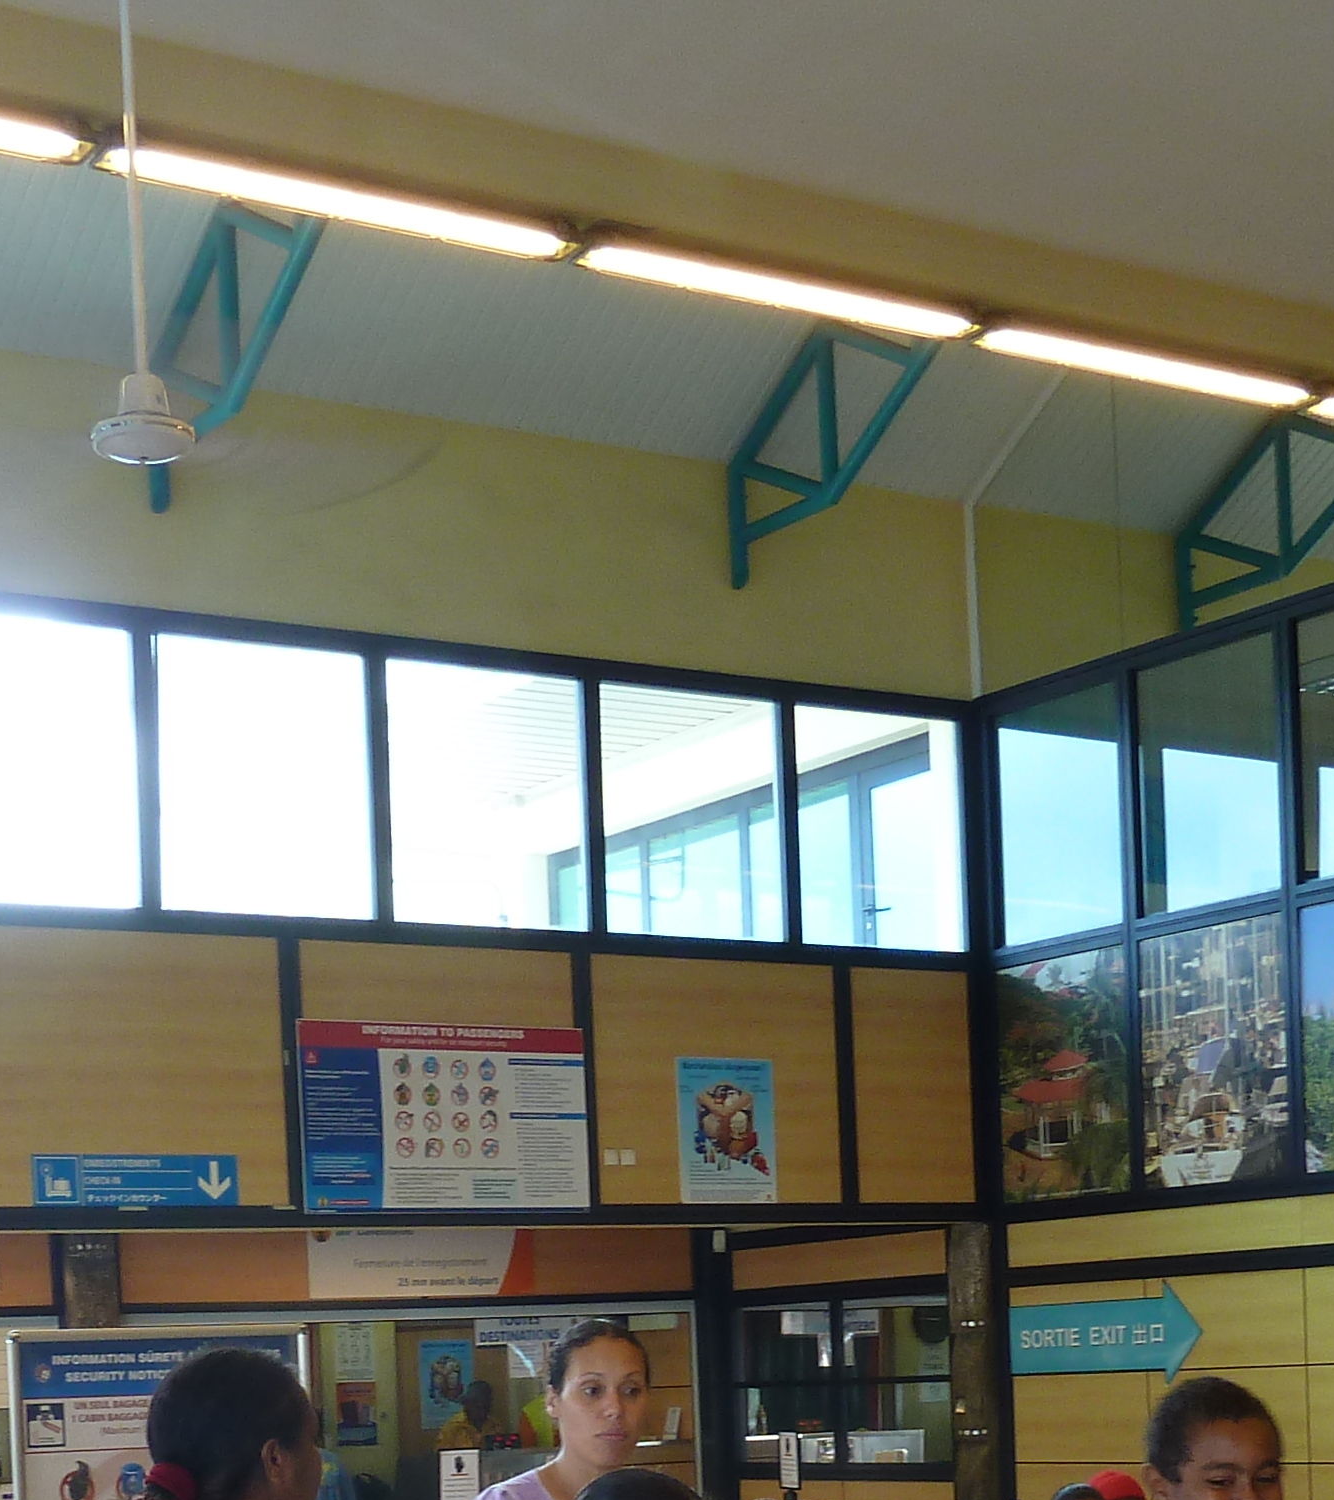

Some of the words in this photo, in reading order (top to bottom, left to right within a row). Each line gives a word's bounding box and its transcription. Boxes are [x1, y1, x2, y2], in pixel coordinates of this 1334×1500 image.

[362, 1025, 437, 1036] INFORMATION
[440, 1027, 455, 1037] TO
[456, 1028, 525, 1040] PASSENGERS
[479, 1328, 561, 1342] DESTINATIONS
[1020, 1328, 1081, 1349] SORTIE
[1089, 1325, 1128, 1346] EXIT
[1132, 1322, 1165, 1346] 出口
[52, 1354, 136, 1366] INFORMATION
[65, 1371, 126, 1382] SECURITY
